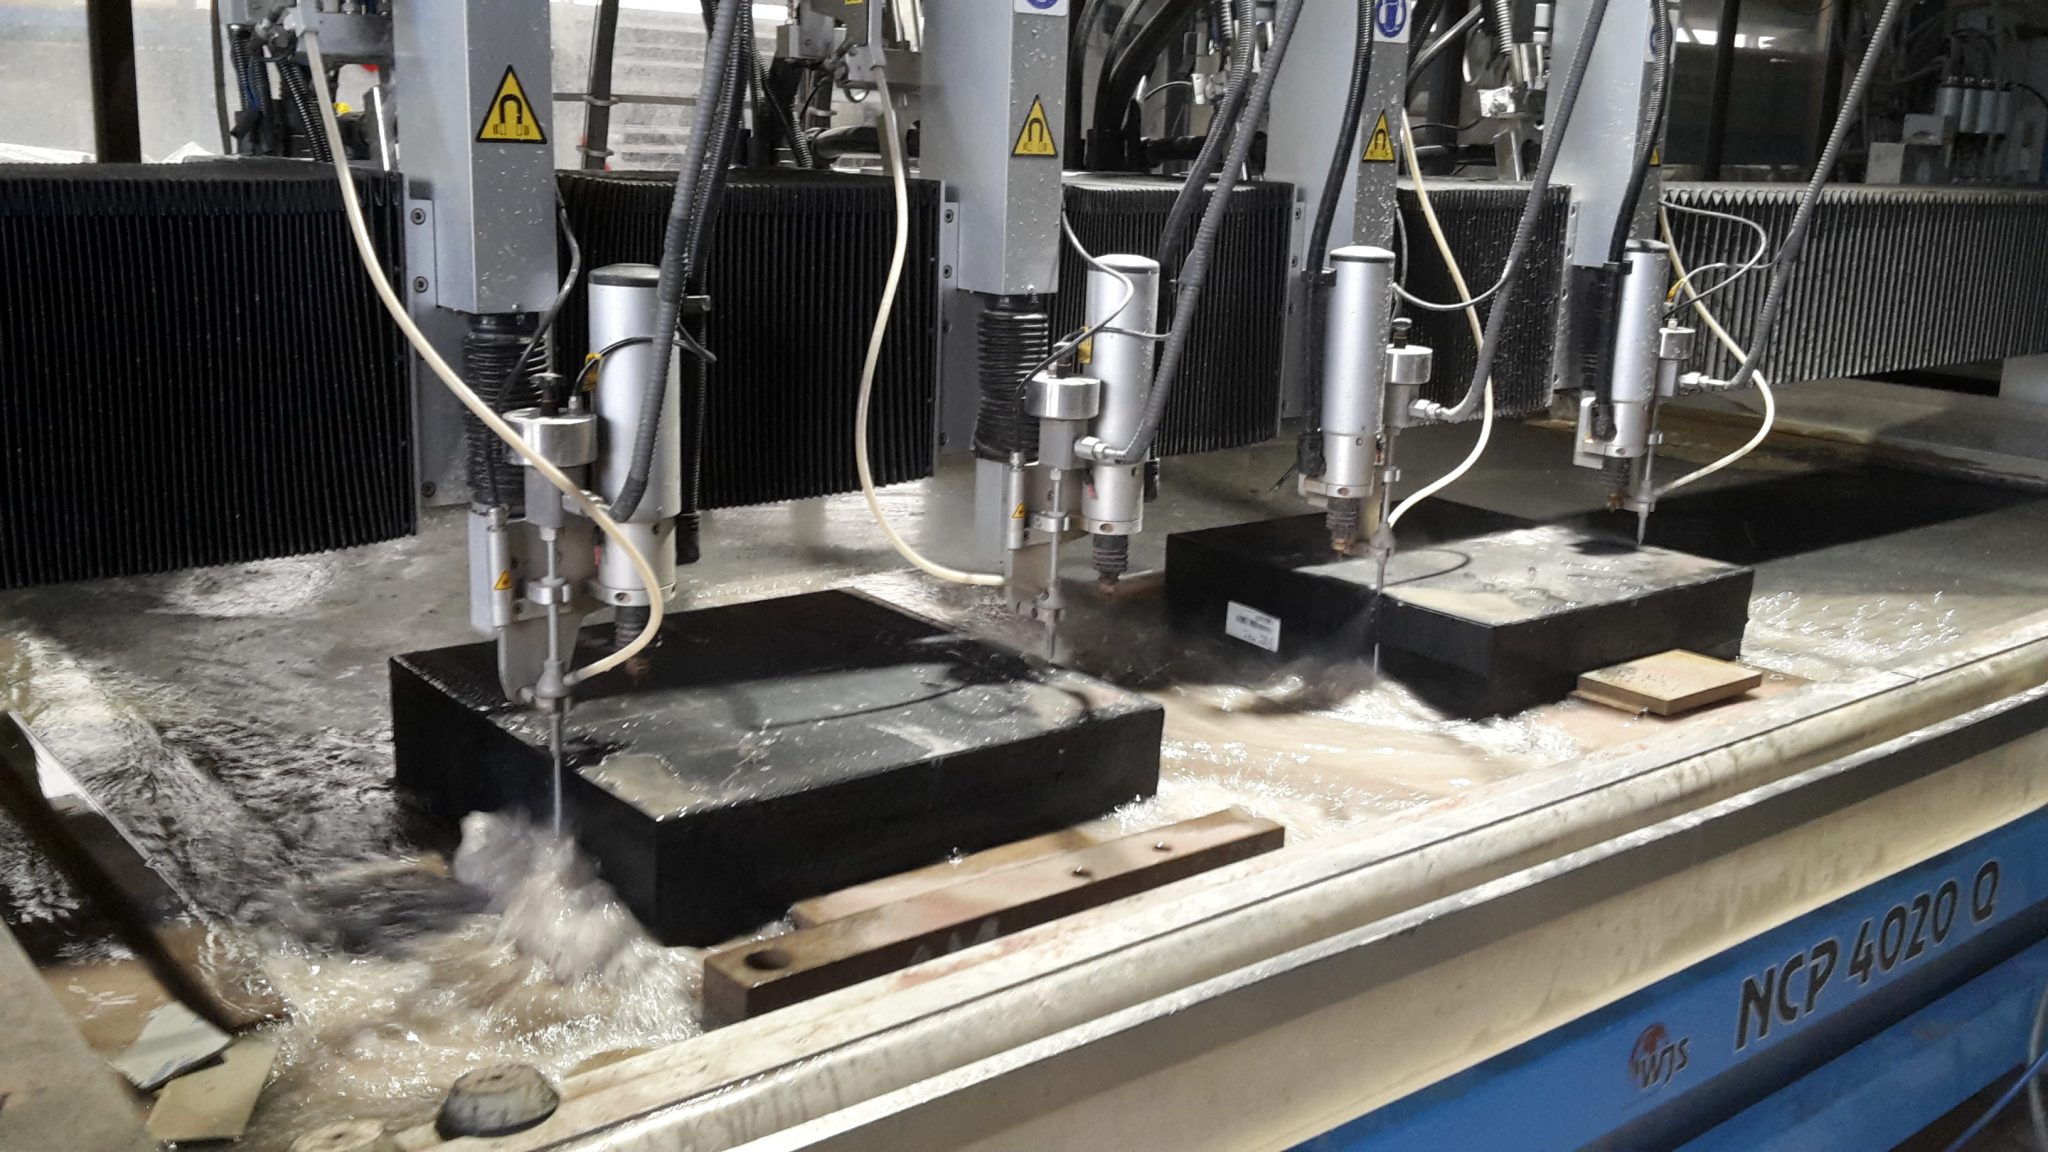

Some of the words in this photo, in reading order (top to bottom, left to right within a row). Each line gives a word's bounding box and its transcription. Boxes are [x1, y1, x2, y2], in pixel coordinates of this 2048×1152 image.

[1735, 939, 1839, 1052] NCP
[1847, 880, 1958, 986] 4020
[1972, 860, 1999, 924] Q
